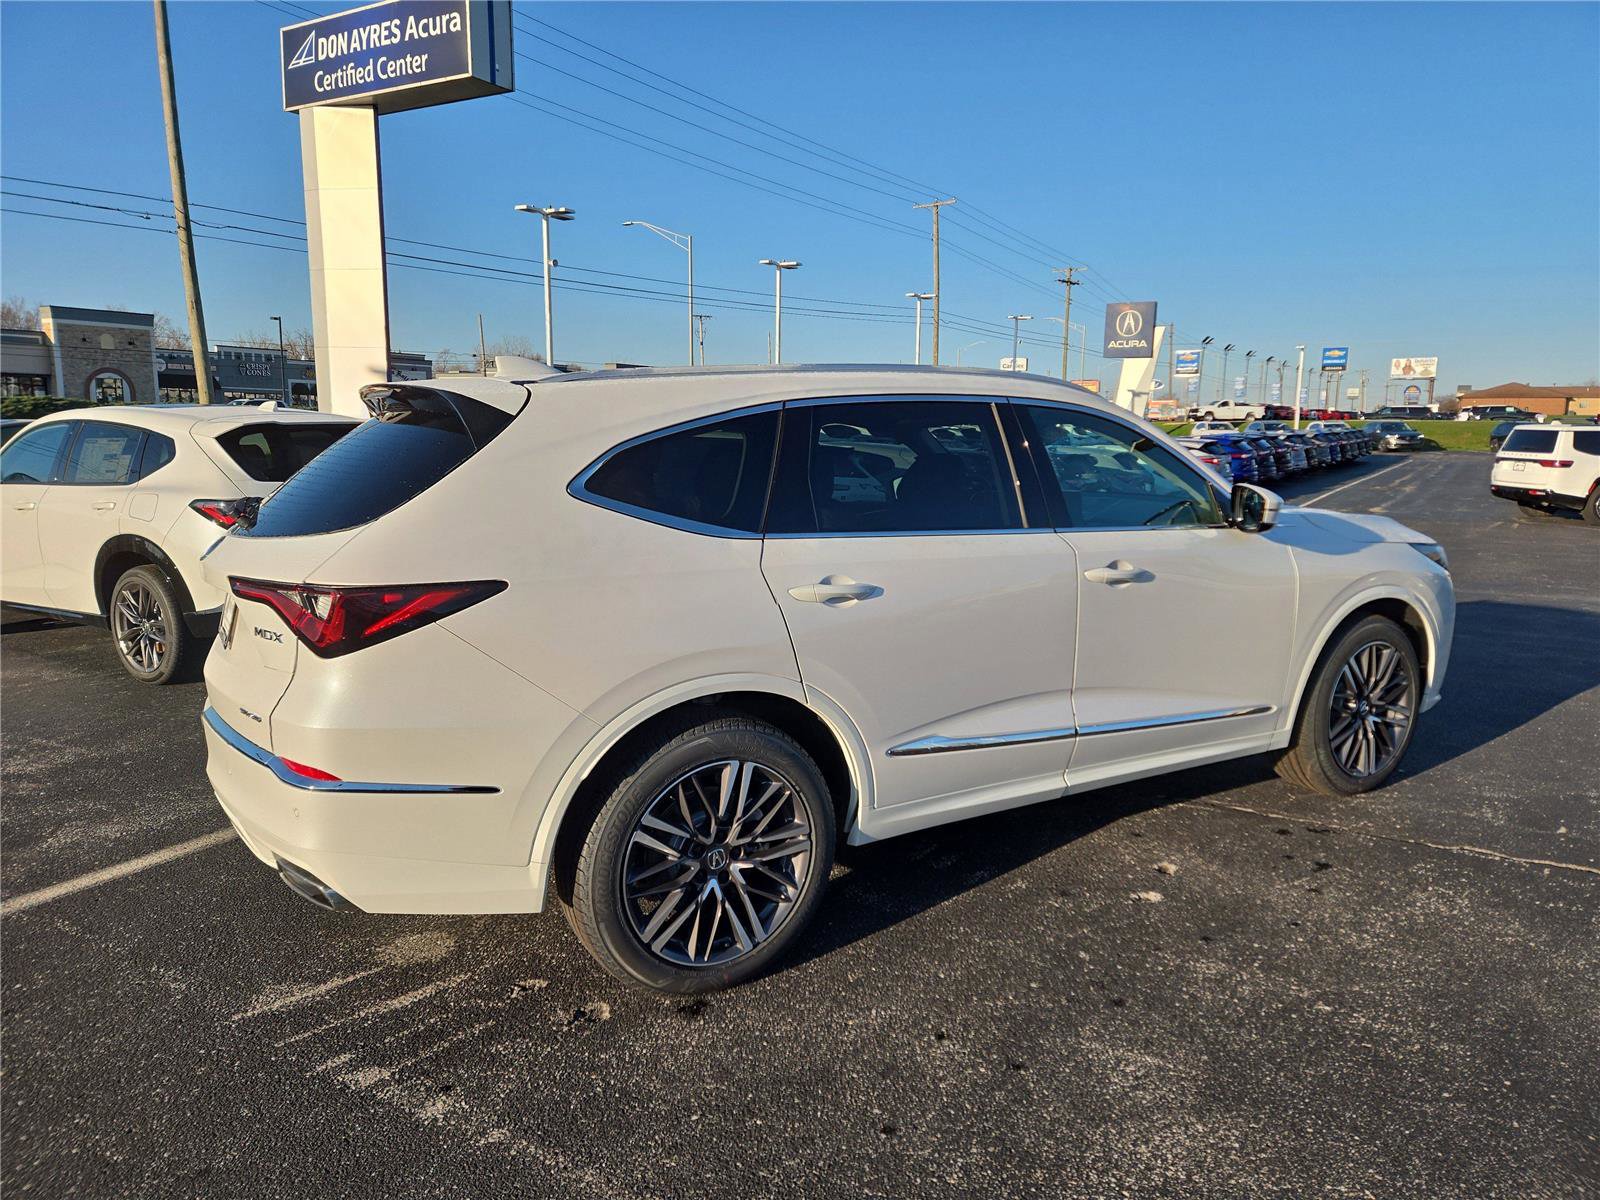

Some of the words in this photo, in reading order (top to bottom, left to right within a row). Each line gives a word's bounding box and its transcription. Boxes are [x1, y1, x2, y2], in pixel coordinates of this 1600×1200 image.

[317, 33, 348, 61] DON
[350, 19, 401, 52] AYRES
[404, 11, 461, 42] Acura
[314, 57, 374, 93] Certified
[376, 53, 428, 81] Center
[1107, 340, 1147, 348] ACURA
[246, 362, 271, 370] CRISPY
[246, 369, 271, 377] CONES
[254, 626, 284, 644] MDX
